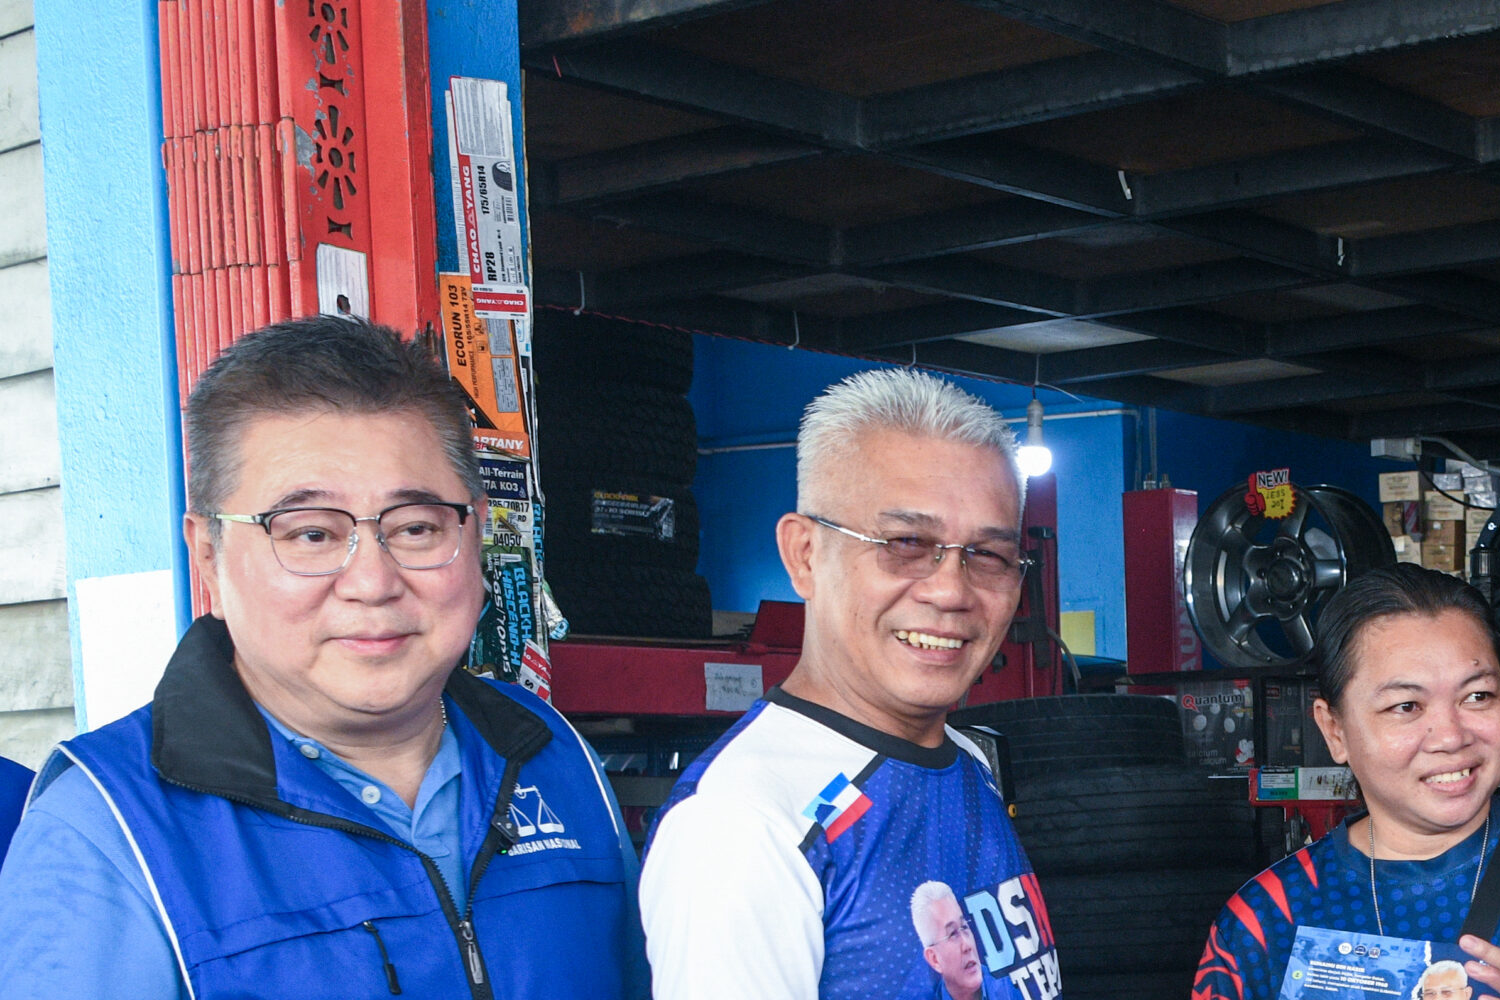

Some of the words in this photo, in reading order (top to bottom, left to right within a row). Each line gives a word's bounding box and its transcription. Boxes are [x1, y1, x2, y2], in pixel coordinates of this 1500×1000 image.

[485, 251, 498, 281] RP28
[448, 284, 458, 307] 103
[452, 312, 467, 367] ECORUN
[1257, 470, 1288, 488] NEW!
[513, 567, 533, 644] BLACKH
[1182, 693, 1243, 713] Quantum
